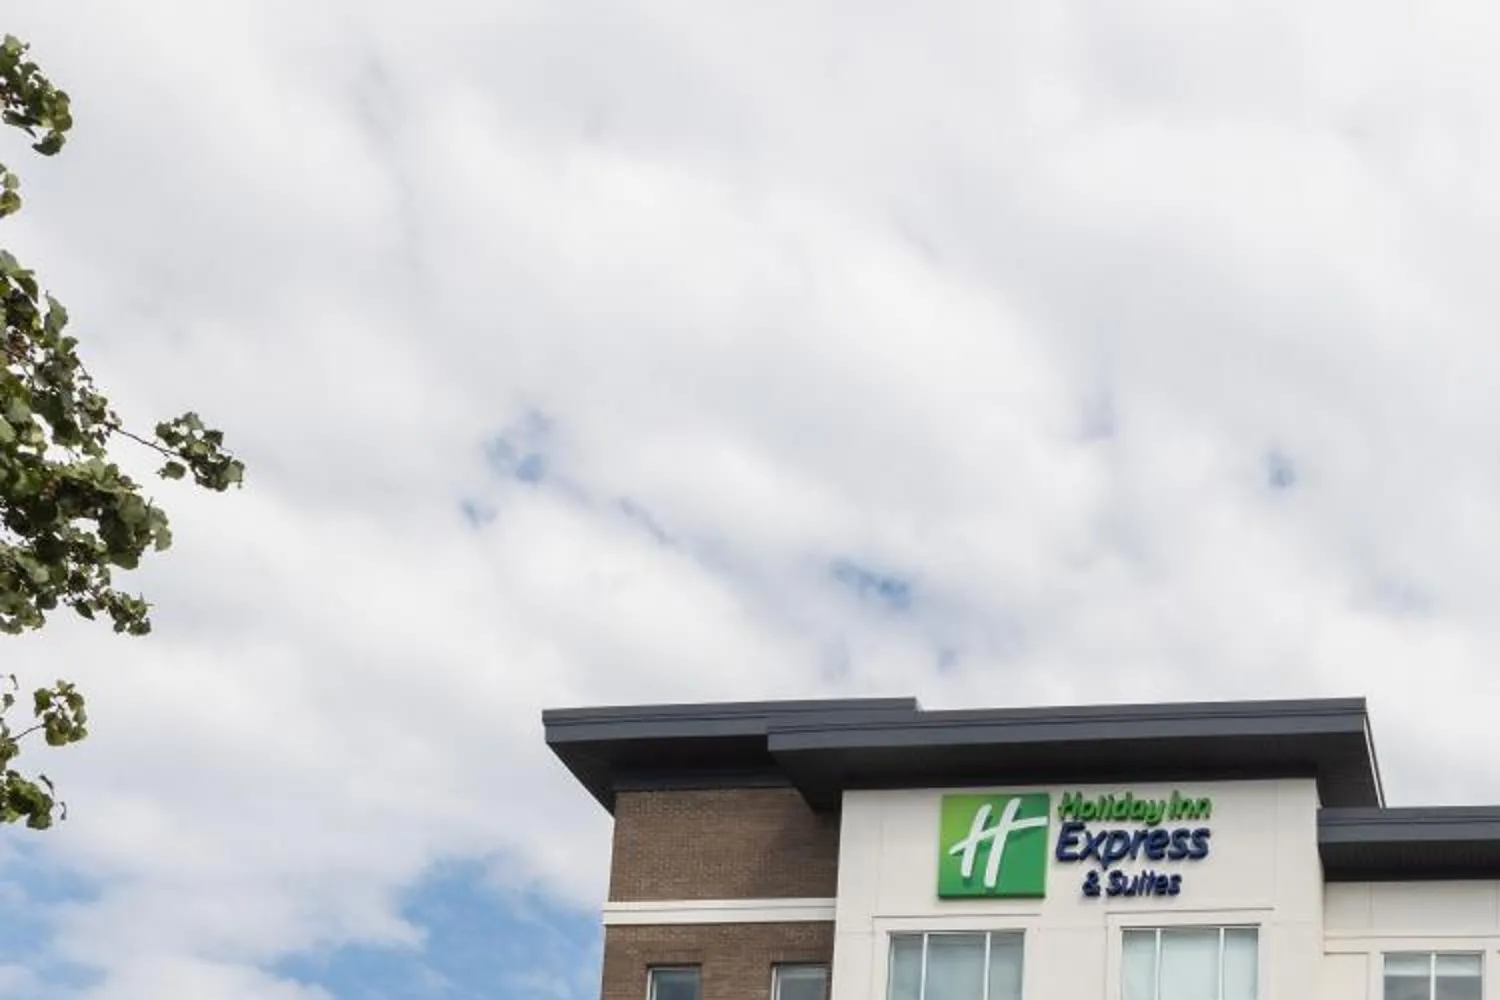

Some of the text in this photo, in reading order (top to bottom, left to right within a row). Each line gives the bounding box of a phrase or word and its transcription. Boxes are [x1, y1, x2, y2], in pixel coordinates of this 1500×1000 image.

[1057, 790, 1212, 826] Holiday Inn
[1055, 821, 1211, 869] Express
[1081, 870, 1182, 897] & Suites
